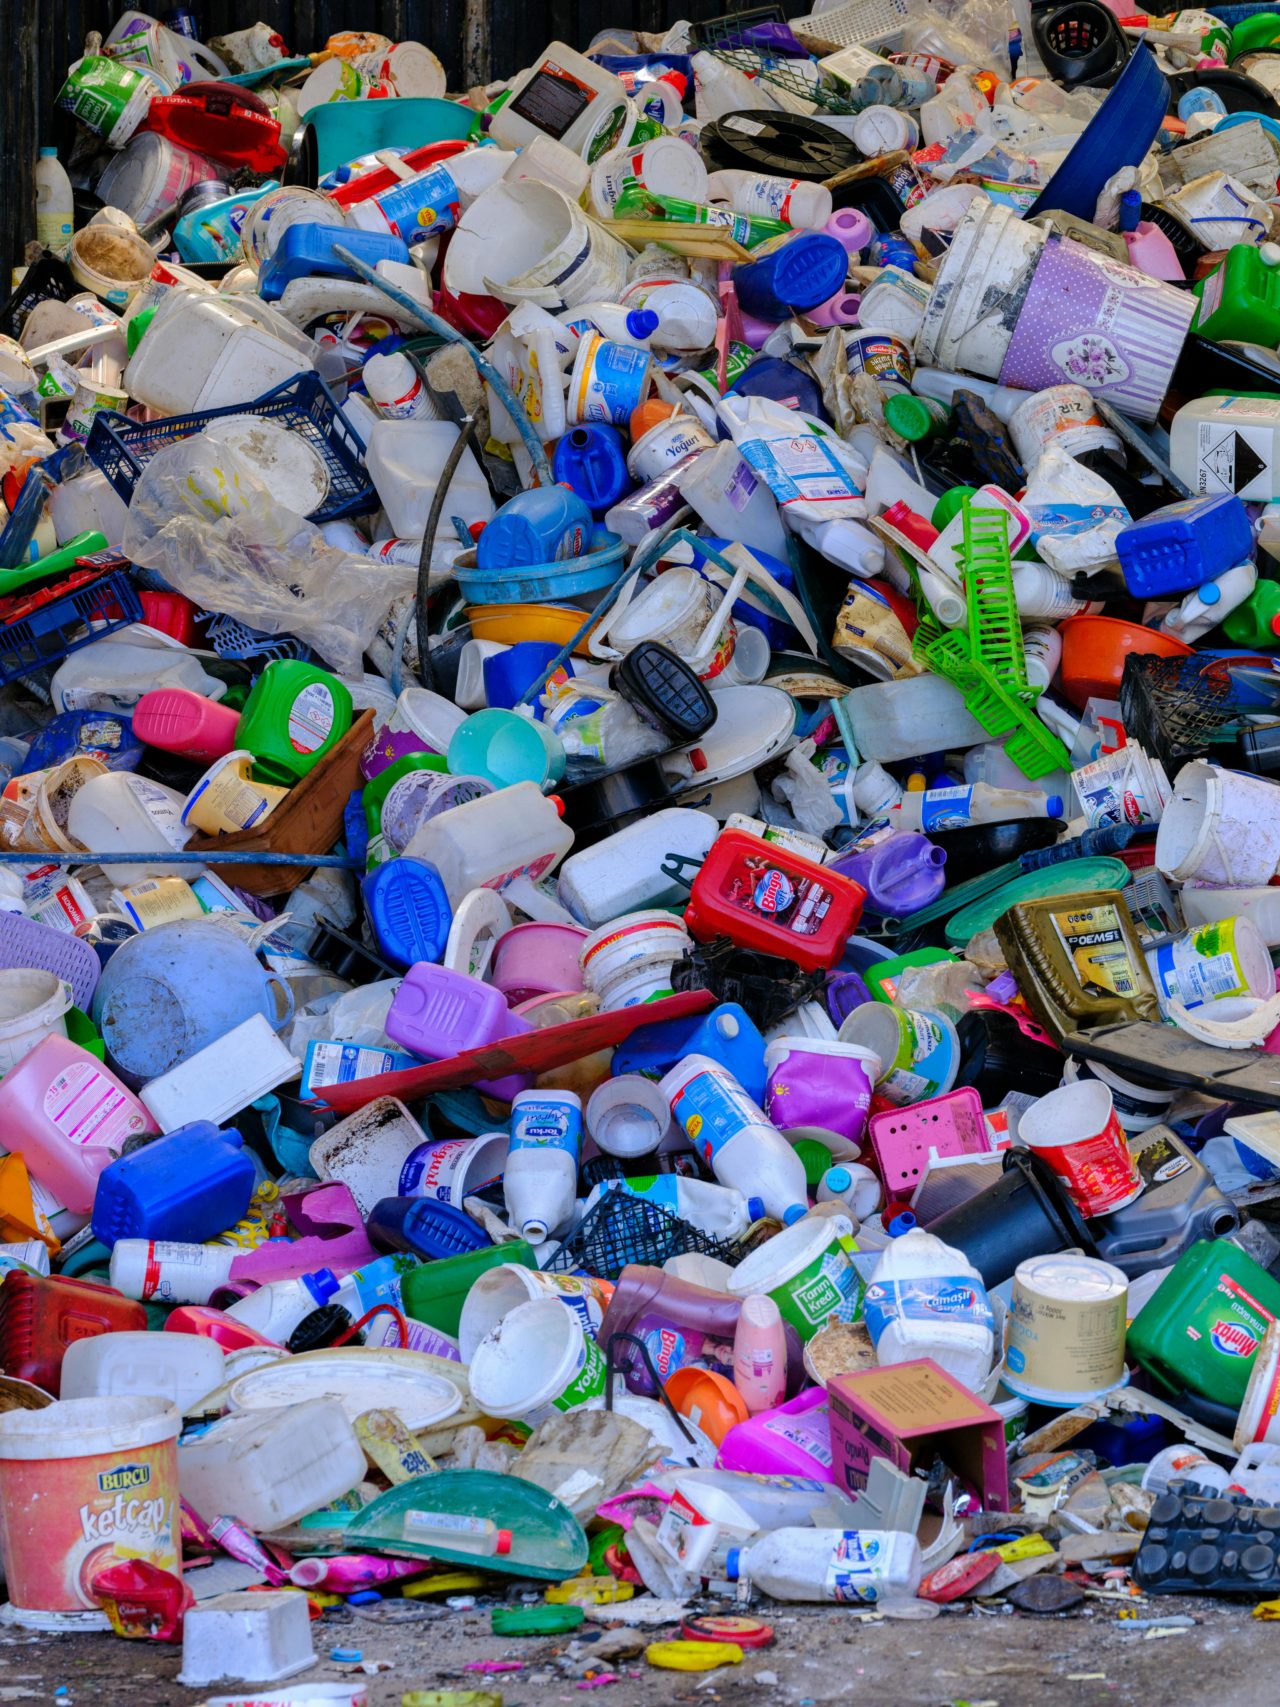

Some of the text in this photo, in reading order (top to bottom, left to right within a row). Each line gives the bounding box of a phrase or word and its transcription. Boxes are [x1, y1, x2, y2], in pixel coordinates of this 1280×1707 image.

[166, 96, 193, 104] TOTAL
[253, 110, 279, 128] TOTAL
[666, 435, 700, 461] Yoğurt
[1200, 468, 1208, 495] UN3267
[761, 870, 782, 912] Bingo
[1078, 931, 1114, 945] 5W30
[527, 1127, 561, 1136] Torku
[801, 1274, 829, 1299] Tarım
[807, 1286, 835, 1313] Kredi
[657, 1327, 677, 1375] Bingo
[1212, 1320, 1259, 1359] Mintax
[575, 1343, 601, 1395] Yoğurt
[102, 1466, 149, 1490] BURCU
[80, 1492, 165, 1544] ketçap
